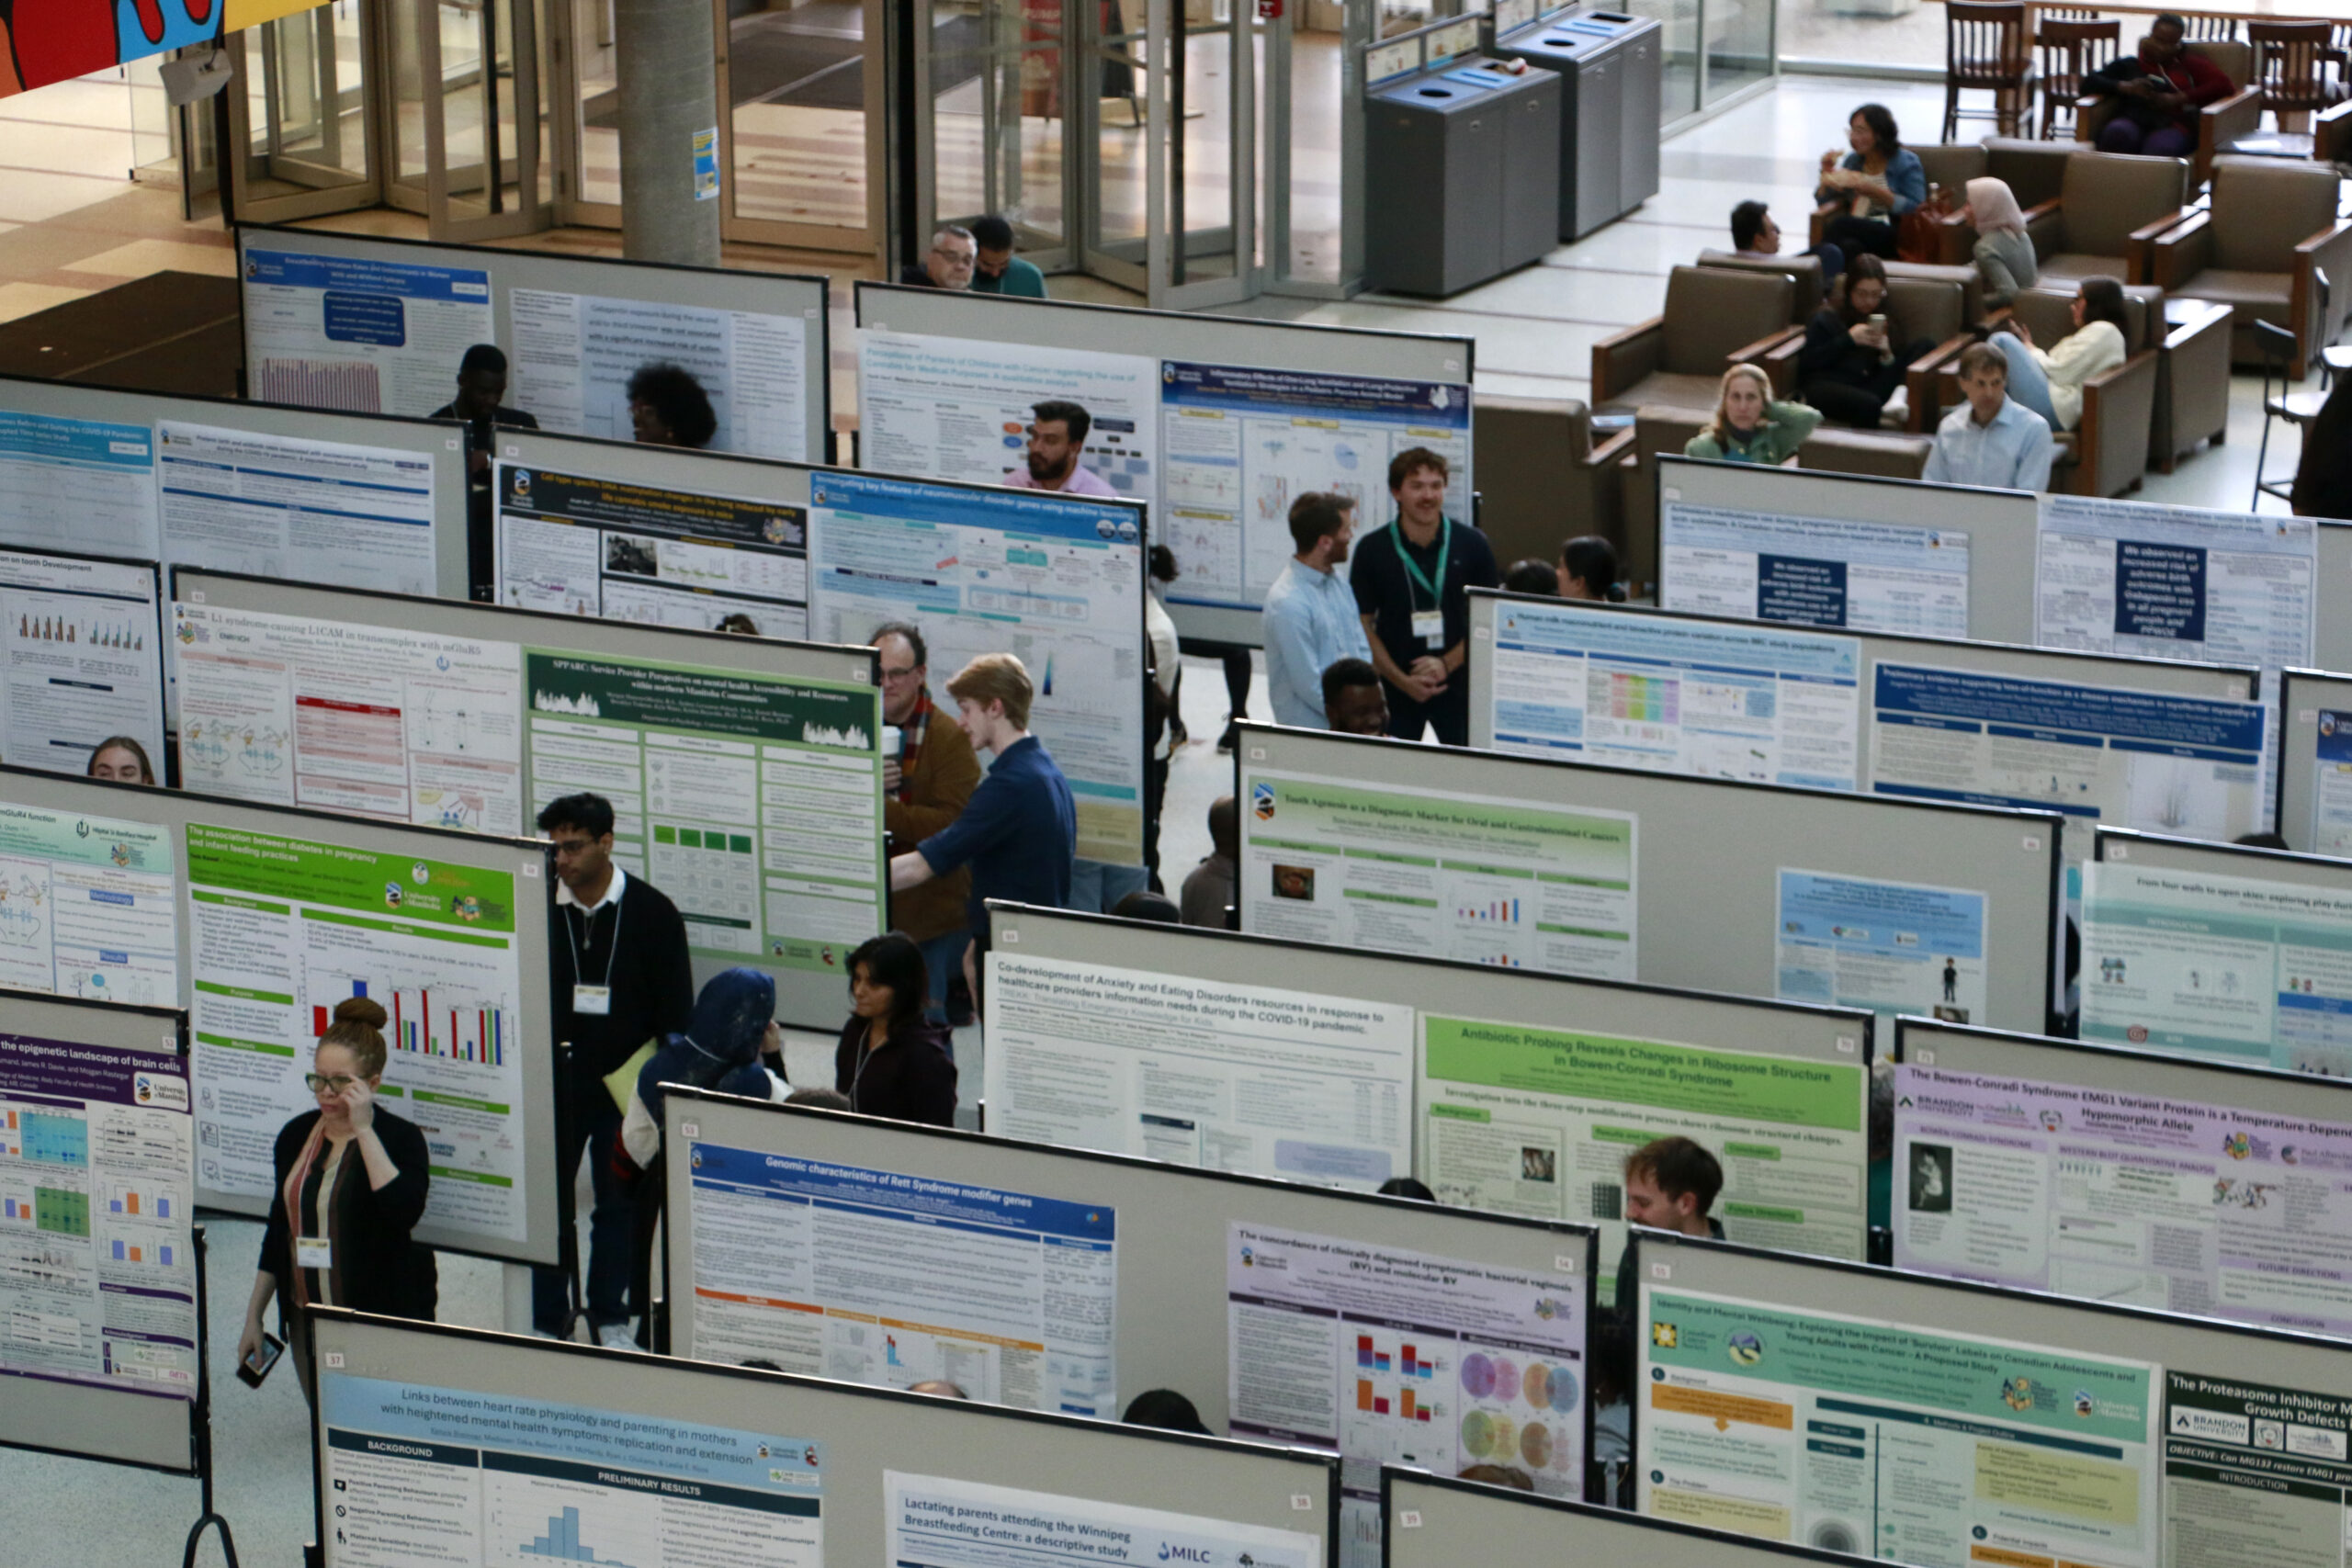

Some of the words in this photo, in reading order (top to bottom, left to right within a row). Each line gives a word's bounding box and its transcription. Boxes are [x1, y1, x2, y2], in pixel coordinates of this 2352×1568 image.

[42, 558, 91, 570] Development
[345, 629, 355, 639] in
[420, 639, 440, 650] with
[28, 812, 56, 823] function
[188, 824, 202, 834] The
[205, 829, 249, 841] association
[253, 834, 285, 847] between
[288, 840, 322, 853] diabetes
[325, 846, 333, 855] in
[334, 849, 377, 864] pregnancy
[189, 838, 202, 846] and
[205, 839, 226, 850] infant
[230, 842, 258, 857] feeding
[261, 849, 298, 861] practices
[2136, 876, 2158, 886] From
[2218, 888, 2239, 897] open
[2268, 894, 2310, 907] exploring
[2312, 898, 2331, 909] play
[998, 961, 1080, 981] Co-development
[1083, 973, 1093, 983] of
[1095, 974, 1135, 991] Anxiety
[1137, 982, 1158, 992] and
[1160, 983, 1193, 999] Eating
[1196, 988, 1247, 1004] Disorders
[1250, 998, 1303, 1011] resources
[1306, 1002, 1316, 1013] in
[1319, 1007, 1368, 1020] response
[1373, 1012, 1383, 1022] to
[998, 975, 1049, 991] healthcare
[1053, 985, 1101, 998] providers
[1103, 989, 1163, 1007] information
[1166, 1000, 1197, 1011] needs
[1201, 1003, 1235, 1019] during
[1238, 1009, 1254, 1020] the
[1258, 1010, 1308, 1026] COVID-19
[1312, 1021, 1367, 1033] pandemic.
[1, 1041, 17, 1051] the
[18, 1043, 67, 1057] epigenetic
[69, 1049, 119, 1066] landscape
[120, 1055, 130, 1066] of
[132, 1056, 156, 1068] brain
[158, 1061, 180, 1071] cells
[1461, 1027, 1521, 1043] Antibiotic
[1523, 1034, 1573, 1053] Probing
[1576, 1041, 1625, 1056] Reveals
[1628, 1047, 1683, 1064] Changes
[1687, 1055, 1698, 1065] in
[1702, 1056, 1766, 1073] Ribosome
[1770, 1065, 1830, 1081] Structure
[1555, 1054, 1566, 1066] in
[1569, 1055, 1665, 1078] Bowen-Conradi
[1668, 1068, 1733, 1087] Syndrome
[153, 1084, 186, 1097] University
[1911, 1067, 1930, 1079] The
[1933, 1071, 2018, 1091] Bowen-Conradi
[2021, 1083, 2078, 1100] Syndrome
[2082, 1091, 2115, 1105] EMG1
[2119, 1096, 2160, 1111] Variant
[2163, 1102, 2205, 1117] Protein
[2209, 1109, 2217, 1119] is
[2081, 1107, 2157, 1126] Hypomorphic
[2161, 1118, 2193, 1131] Allele
[765, 1156, 806, 1171] Genomic
[808, 1163, 876, 1182] characteristics
[878, 1174, 888, 1184] of
[890, 1176, 910, 1188] Rett
[913, 1179, 958, 1195] Syndrome
[961, 1188, 1001, 1201] modifier
[1003, 1195, 1032, 1206] genes
[1657, 1297, 1692, 1314] Identity
[1694, 1305, 1710, 1314] and
[1713, 1306, 1745, 1320] Mental
[1799, 1320, 1843, 1338] Exploring
[1846, 1328, 1860, 1338] the
[1863, 1330, 1895, 1344] Impact
[1899, 1337, 1907, 1346] of
[1957, 1345, 1986, 1359] Labels
[2005, 1353, 2050, 1368] Canadian
[2052, 1360, 2114, 1379] Adolescents
[2117, 1372, 2135, 1382] and
[331, 1356, 340, 1365] 37
[2173, 1376, 2195, 1390] The
[2199, 1380, 2277, 1403] Proteasome
[2280, 1393, 2336, 1412] Inhibitor
[2340, 1402, 2352, 1414] M
[401, 1388, 429, 1402] Links
[433, 1392, 480, 1408] between
[483, 1399, 512, 1413] heart
[514, 1405, 536, 1416] rate
[539, 1406, 597, 1427] physiology
[600, 1416, 620, 1428] and
[624, 1421, 675, 1439] parenting
[679, 1427, 687, 1438] in
[690, 1431, 736, 1446] mothers
[2192, 1415, 2245, 1430] BRANDON
[2245, 1402, 2292, 1420] Growth
[2297, 1410, 2345, 1429] Defects
[380, 1402, 403, 1415] with
[406, 1404, 468, 1424] heightened
[470, 1416, 509, 1429] mental
[513, 1419, 548, 1434] health
[550, 1427, 611, 1443] symptoms:
[614, 1436, 672, 1452] replication
[674, 1445, 695, 1456] and
[699, 1449, 752, 1464] extension
[2192, 1425, 2245, 1438] UNIVERSITY
[368, 1441, 432, 1457] BACKGROUND
[2169, 1444, 2218, 1460] OBJECTIVE:
[2221, 1452, 2236, 1463] Can
[2240, 1456, 2270, 1468] MG132
[2273, 1462, 2304, 1473] restore
[2306, 1466, 2333, 1478] EMG1
[348, 1479, 371, 1488] Positive
[373, 1482, 401, 1494] Parenting
[598, 1472, 658, 1489] PRELIMINARY
[662, 1482, 700, 1495] RESULTS
[2219, 1471, 2288, 1491] INTRODUCTION
[349, 1506, 375, 1515] Negative
[377, 1509, 404, 1520] Parenting
[1297, 1498, 1307, 1507] 38
[905, 1497, 954, 1517] Lactating
[956, 1507, 997, 1521] parents
[1001, 1514, 1053, 1532] attending
[1057, 1521, 1074, 1533] the
[1077, 1523, 1130, 1544] Winnipeg
[1407, 1516, 1417, 1524] 39
[905, 1513, 978, 1538] Breastfeeding
[982, 1525, 1021, 1541] Centre:
[1034, 1533, 1093, 1552] descriptive
[1097, 1545, 1127, 1561] study
[1171, 1546, 1211, 1563] MILC
